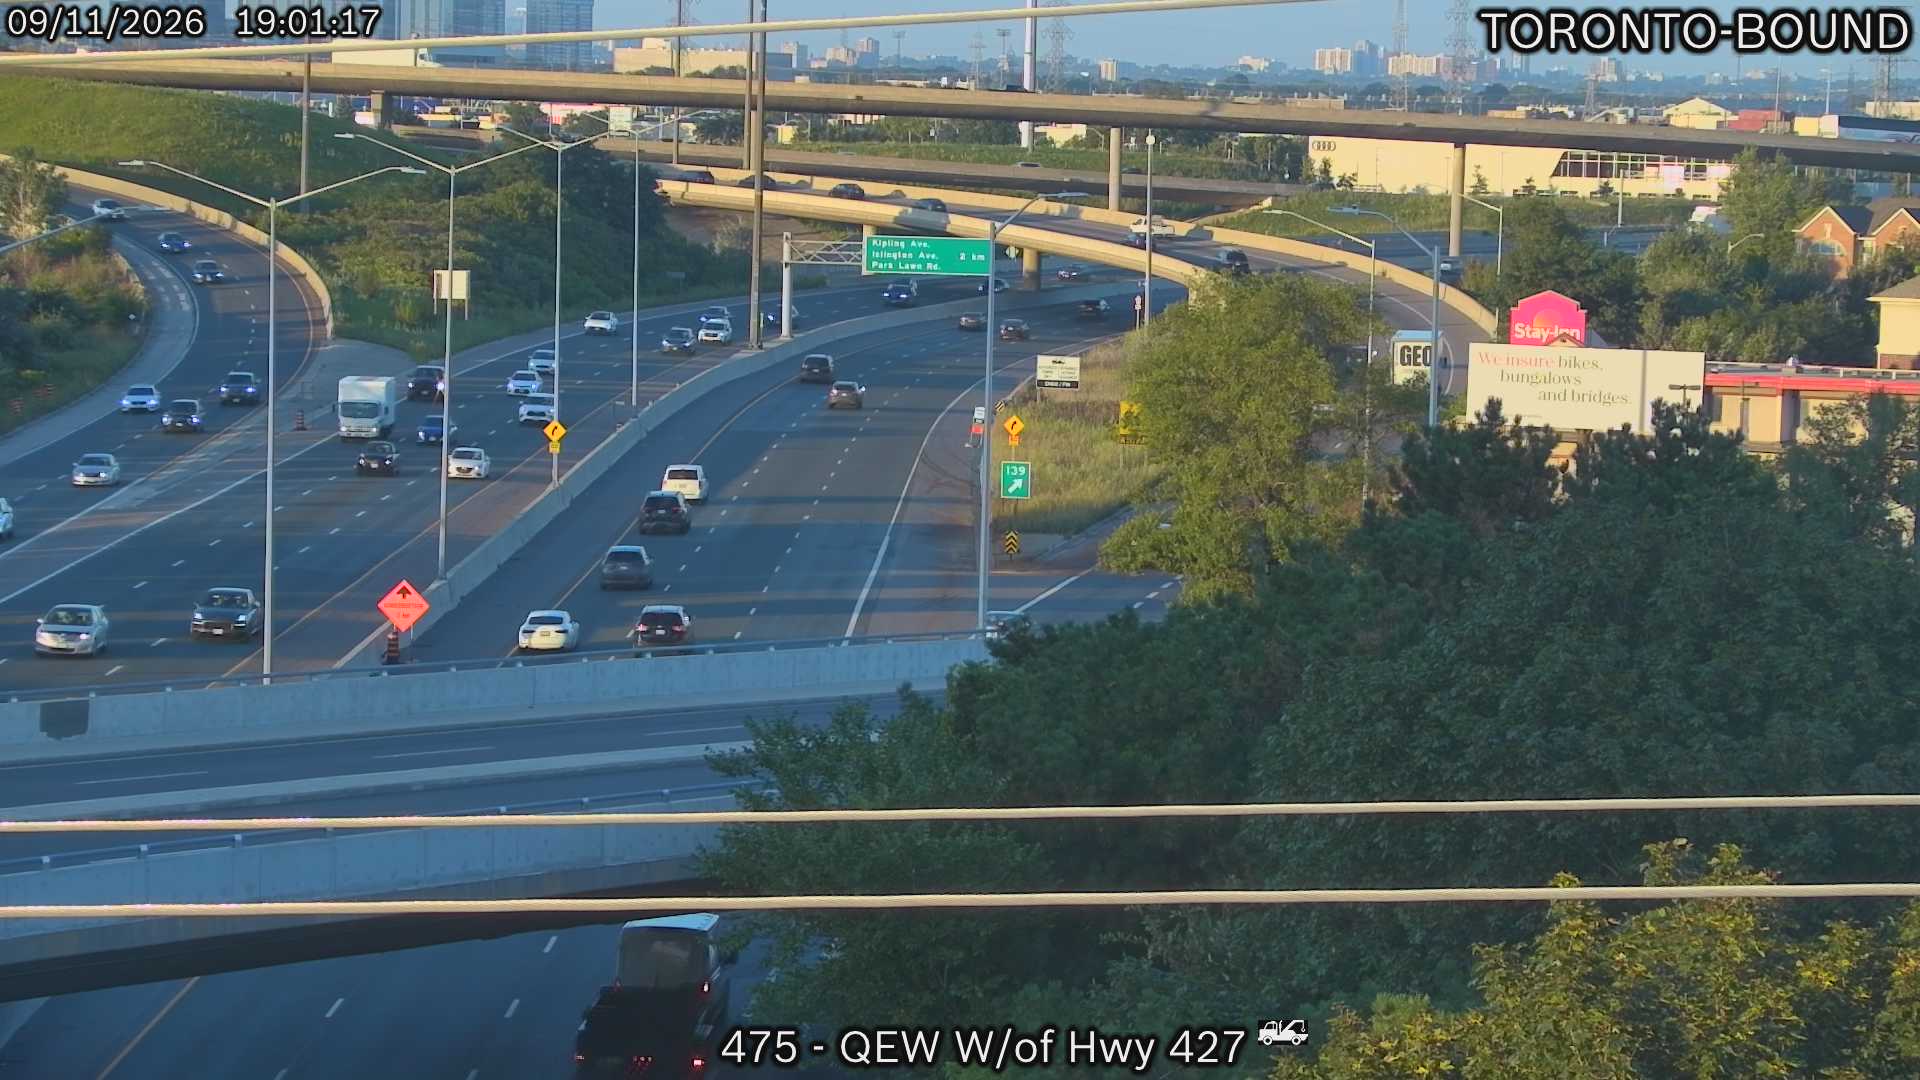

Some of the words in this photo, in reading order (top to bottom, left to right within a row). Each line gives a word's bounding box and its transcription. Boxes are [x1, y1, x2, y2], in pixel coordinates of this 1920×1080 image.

[872, 239, 905, 249] Kipling
[911, 240, 930, 248] Ave.
[872, 250, 913, 260] Islington
[919, 251, 938, 260] Ave.
[959, 252, 966, 261] 2
[971, 252, 985, 261] km
[871, 261, 893, 269] Park
[899, 262, 922, 270] Lawn
[926, 263, 941, 271] Rd.
[1514, 322, 1581, 342] Stay-Inn
[1478, 351, 1500, 365] We
[1506, 353, 1553, 368] insure
[1558, 355, 1604, 371] bikes,
[1499, 370, 1582, 386] bungalows
[1538, 388, 1567, 402] and
[1571, 389, 1632, 407] bridges.
[1006, 466, 1026, 475] 139
